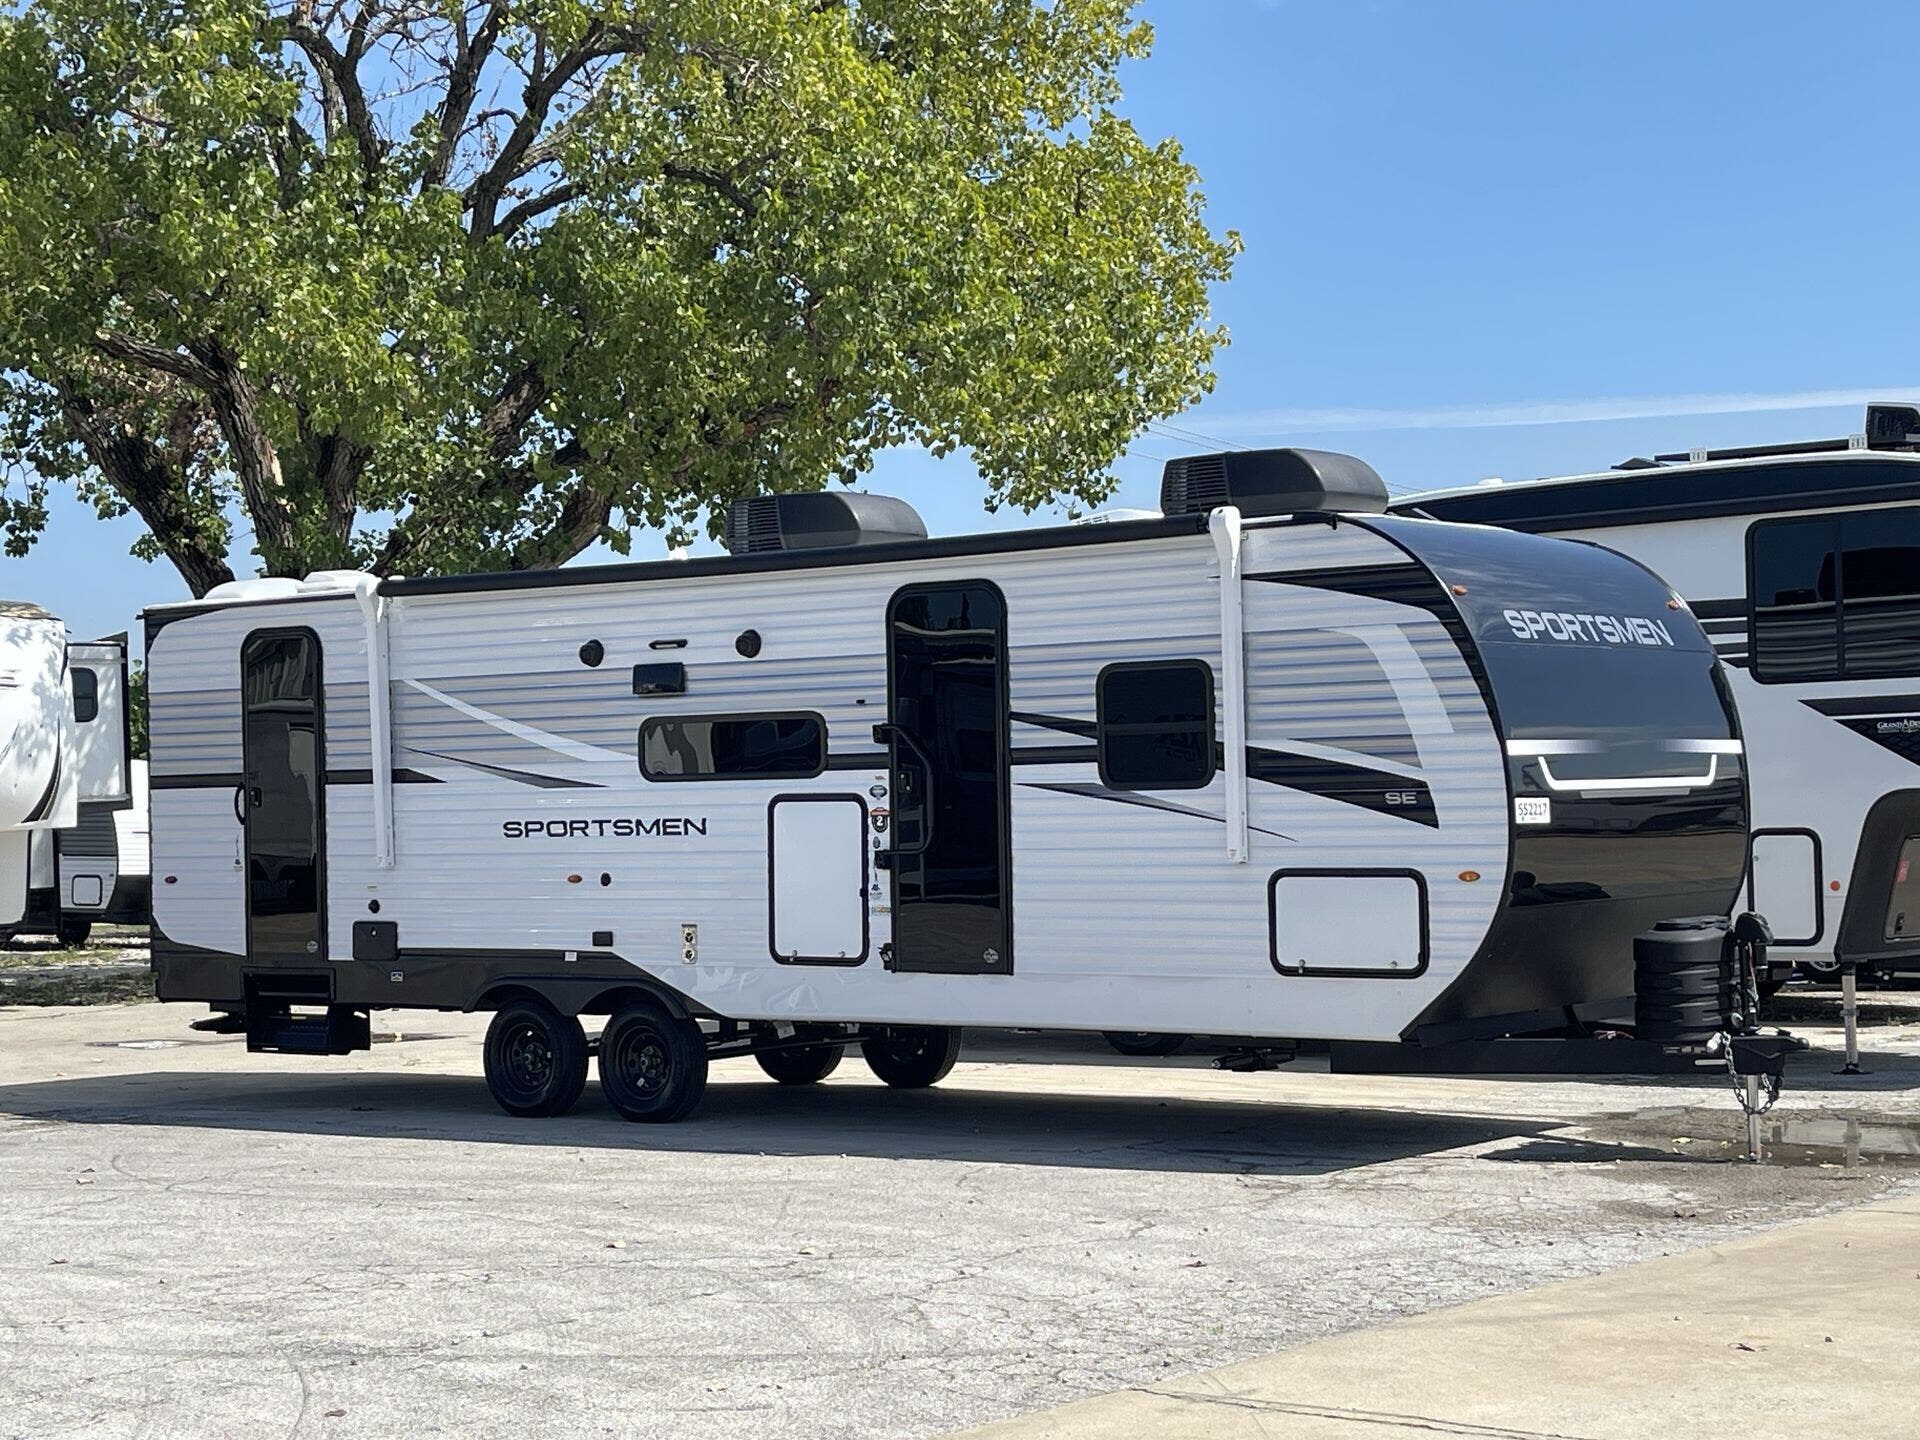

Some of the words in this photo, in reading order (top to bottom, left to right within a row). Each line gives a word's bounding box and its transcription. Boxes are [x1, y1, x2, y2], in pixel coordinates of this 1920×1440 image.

[1503, 609, 1675, 646] SPORTSMEN
[1384, 791, 1418, 805] SE
[503, 817, 707, 838] SPORTSMEN
[876, 815, 883, 827] 2
